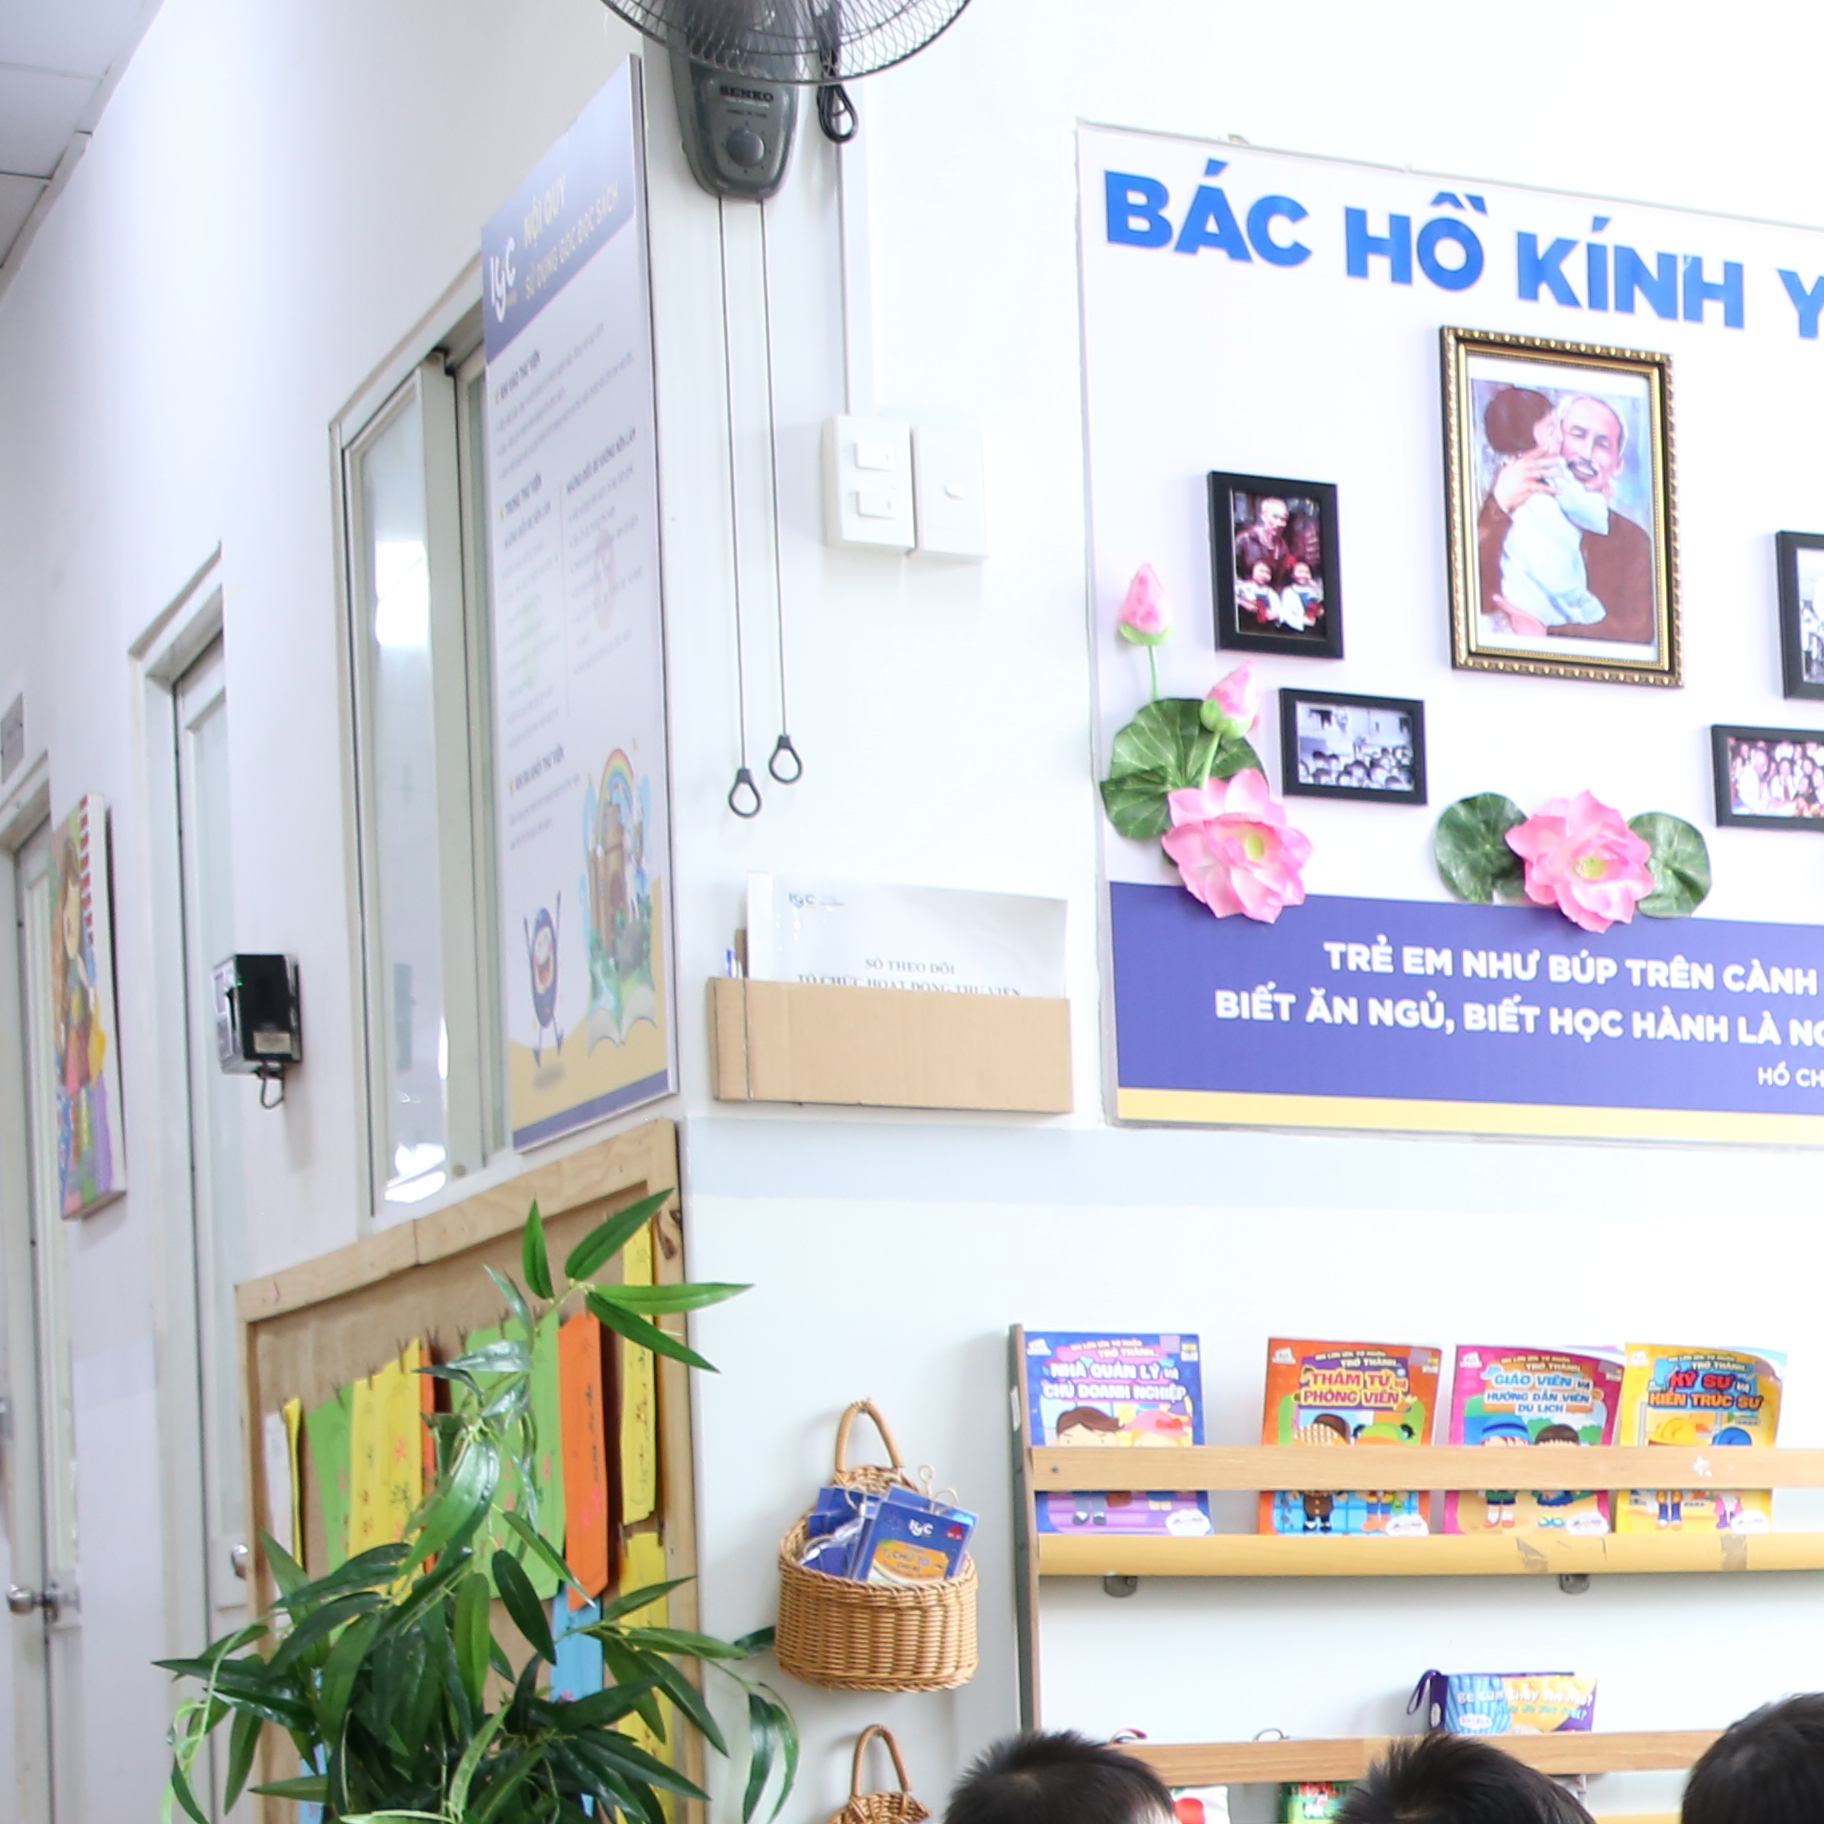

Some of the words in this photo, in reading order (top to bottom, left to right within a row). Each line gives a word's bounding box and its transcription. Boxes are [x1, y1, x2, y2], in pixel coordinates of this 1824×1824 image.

[1105, 158, 1312, 266] BÁC
[1345, 191, 1487, 291] HỒ
[1517, 216, 1744, 328] KÍNH
[1323, 933, 1394, 973] TRẺ
[1402, 945, 1453, 976] EM
[1462, 948, 1541, 981] NHƯ
[1548, 949, 1618, 985] BÚP
[1624, 954, 1715, 990] TRÊN
[1722, 958, 1818, 996] CÀNH
[1215, 980, 1297, 1022] BIẾT
[1306, 987, 1359, 1025] ĂN
[1368, 989, 1455, 1035] NGỦ,
[1463, 994, 1541, 1034] BIẾT
[1549, 1006, 1625, 1043] HỌC
[1631, 1005, 1730, 1044] HÀNH
[1737, 1010, 1782, 1046] LÀ
[1077, 1385, 1131, 1400] DOANH
[1494, 1372, 1531, 1386] GIÁO
[1537, 1374, 1572, 1387] VIÊN
[1518, 1404, 1534, 1412] DU
